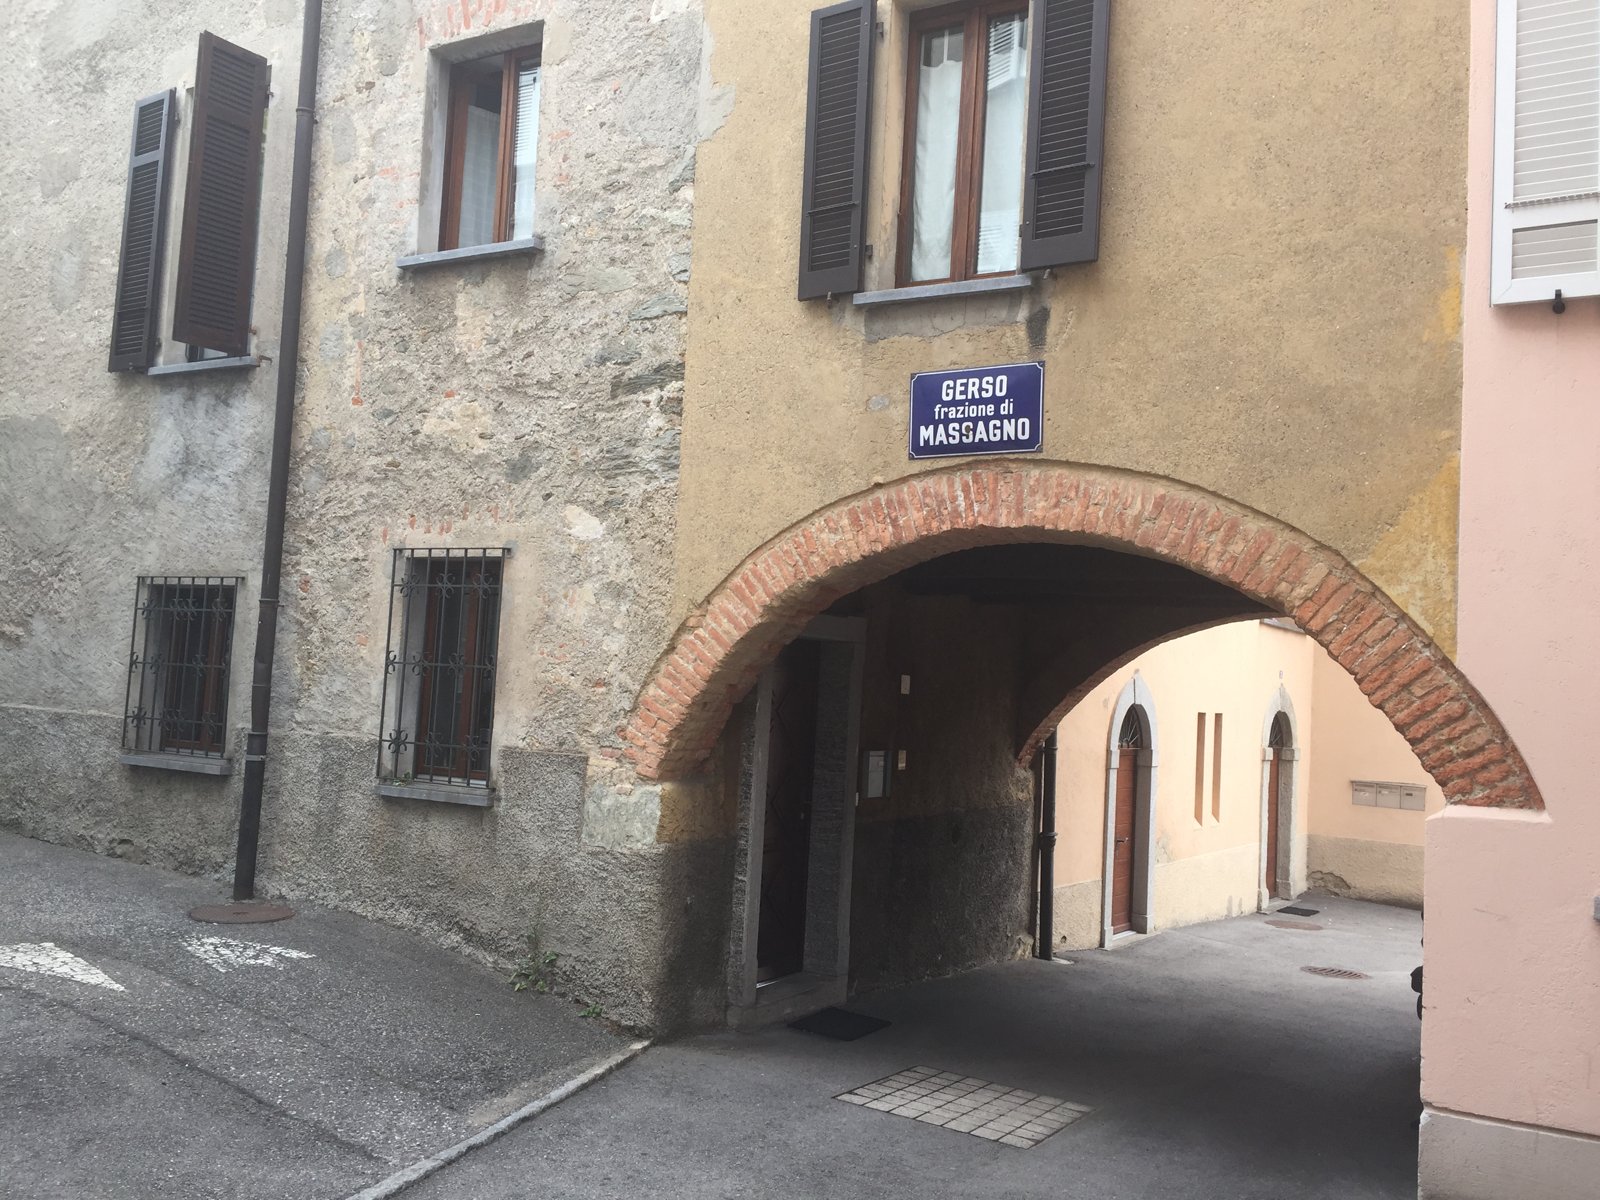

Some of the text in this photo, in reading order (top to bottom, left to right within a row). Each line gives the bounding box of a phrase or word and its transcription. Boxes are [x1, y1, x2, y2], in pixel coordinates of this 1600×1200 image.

[942, 375, 1007, 401] GERSO
[934, 399, 1013, 420] frazione di
[919, 418, 1030, 447] MASSAGNO
